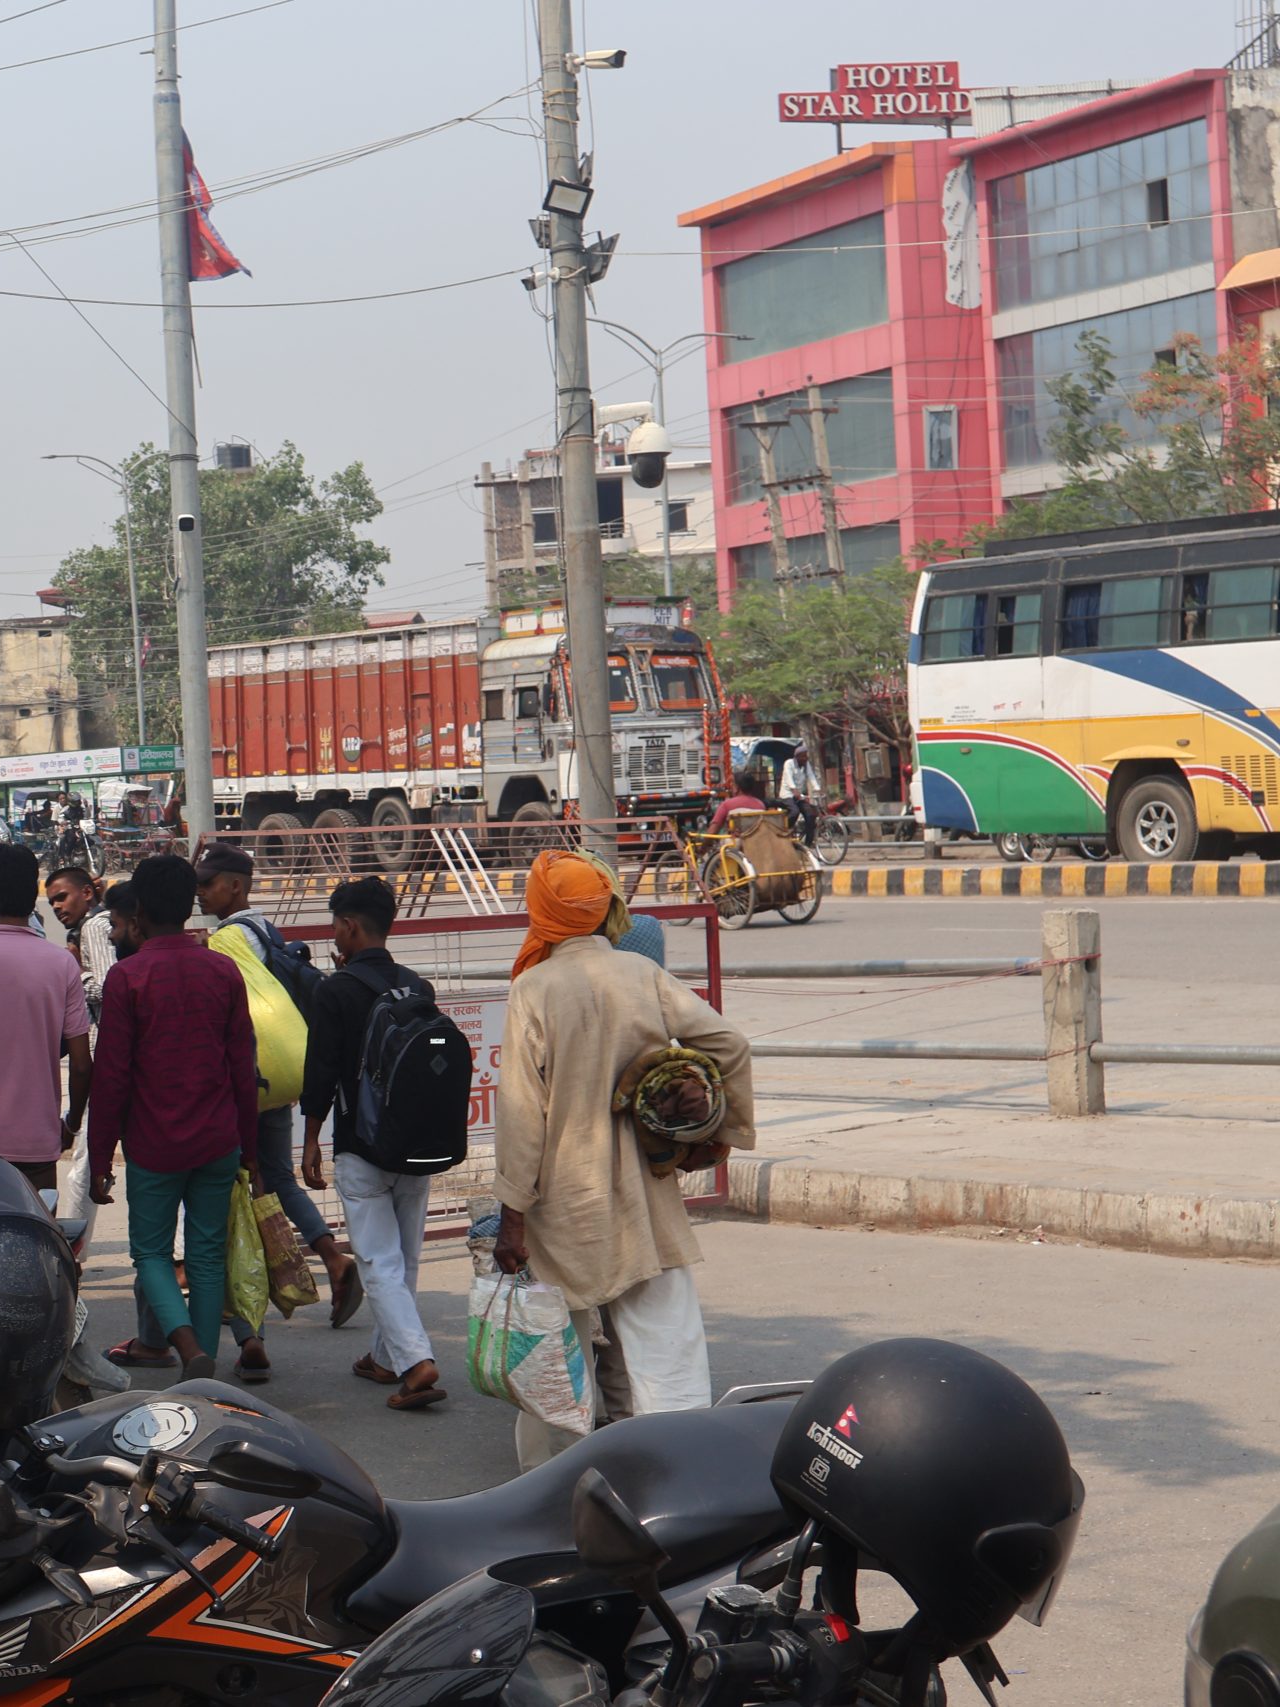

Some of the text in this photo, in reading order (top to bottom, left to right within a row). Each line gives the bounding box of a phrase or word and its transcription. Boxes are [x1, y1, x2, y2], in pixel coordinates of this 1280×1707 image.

[844, 64, 953, 89] HOTEL
[783, 91, 974, 117] STAR HOLID
[645, 739, 666, 747] TATA
[807, 1421, 864, 1469] Kohinoor
